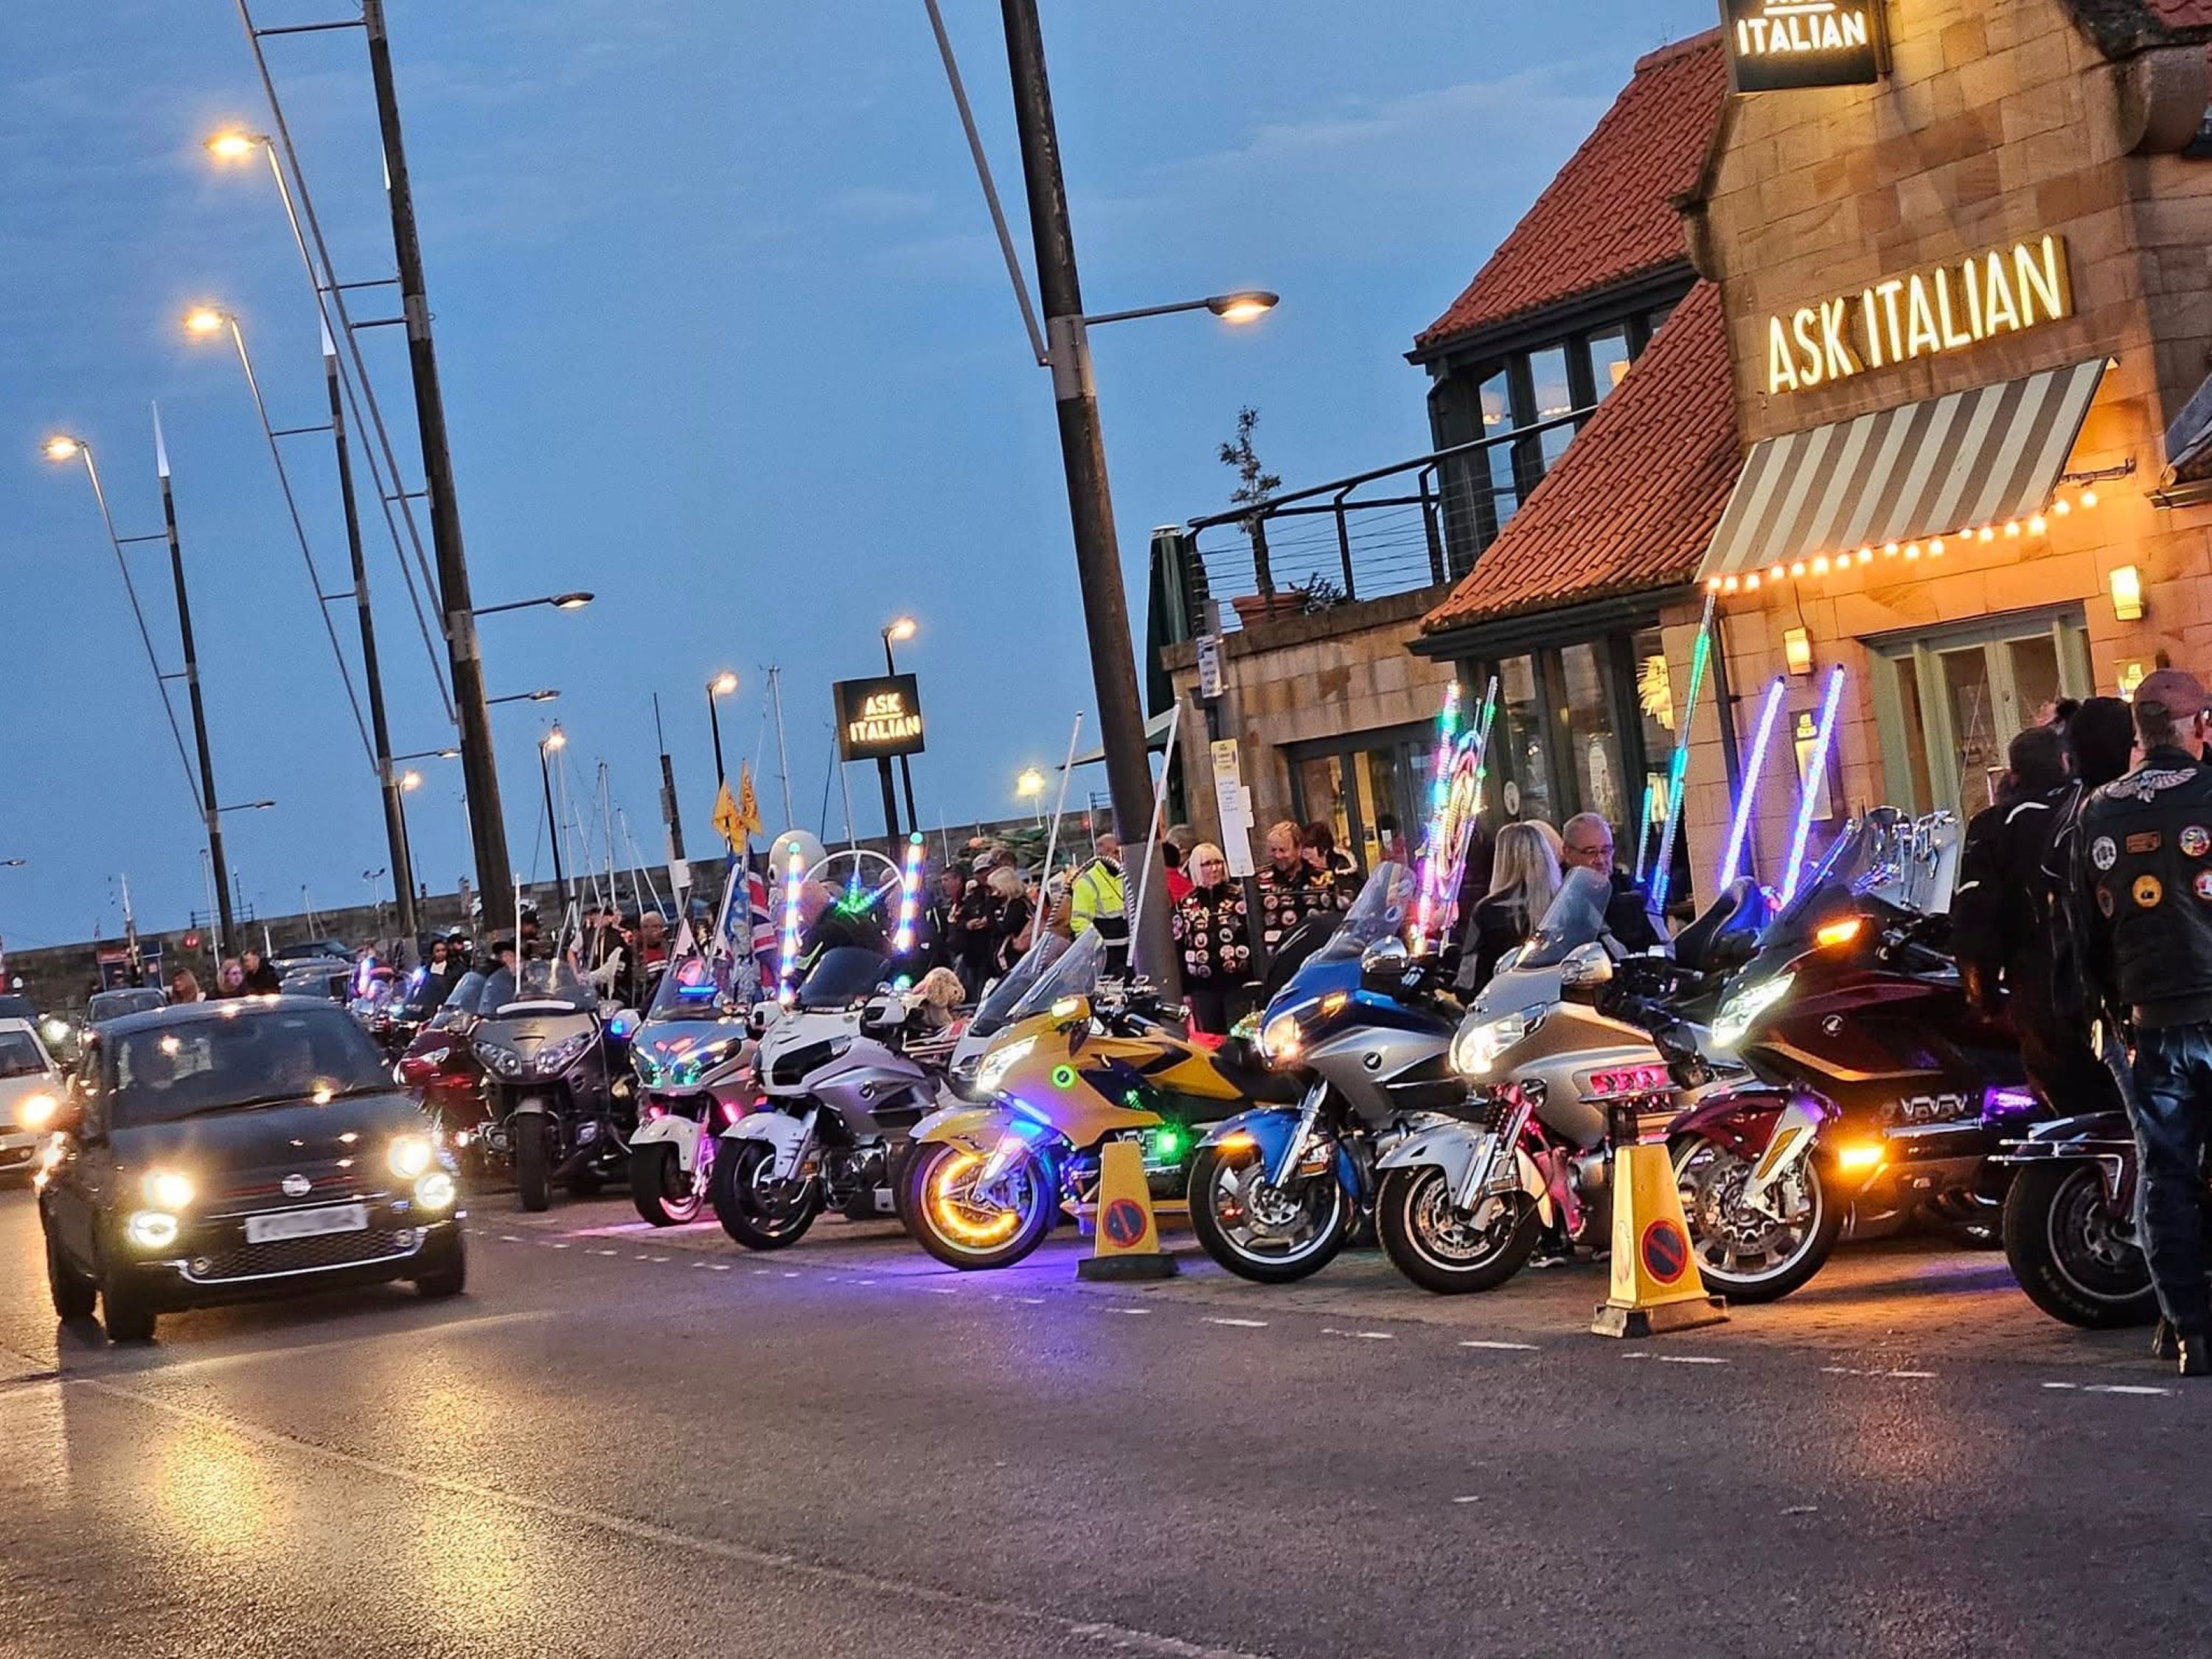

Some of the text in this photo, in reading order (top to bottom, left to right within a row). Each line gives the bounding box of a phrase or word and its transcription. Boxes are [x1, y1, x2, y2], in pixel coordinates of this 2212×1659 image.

[1736, 10, 1867, 56] ITALIAN
[1769, 234, 2063, 394] ASK ITALIAN
[864, 692, 902, 716] ASK
[849, 714, 921, 742] ITALIAN
